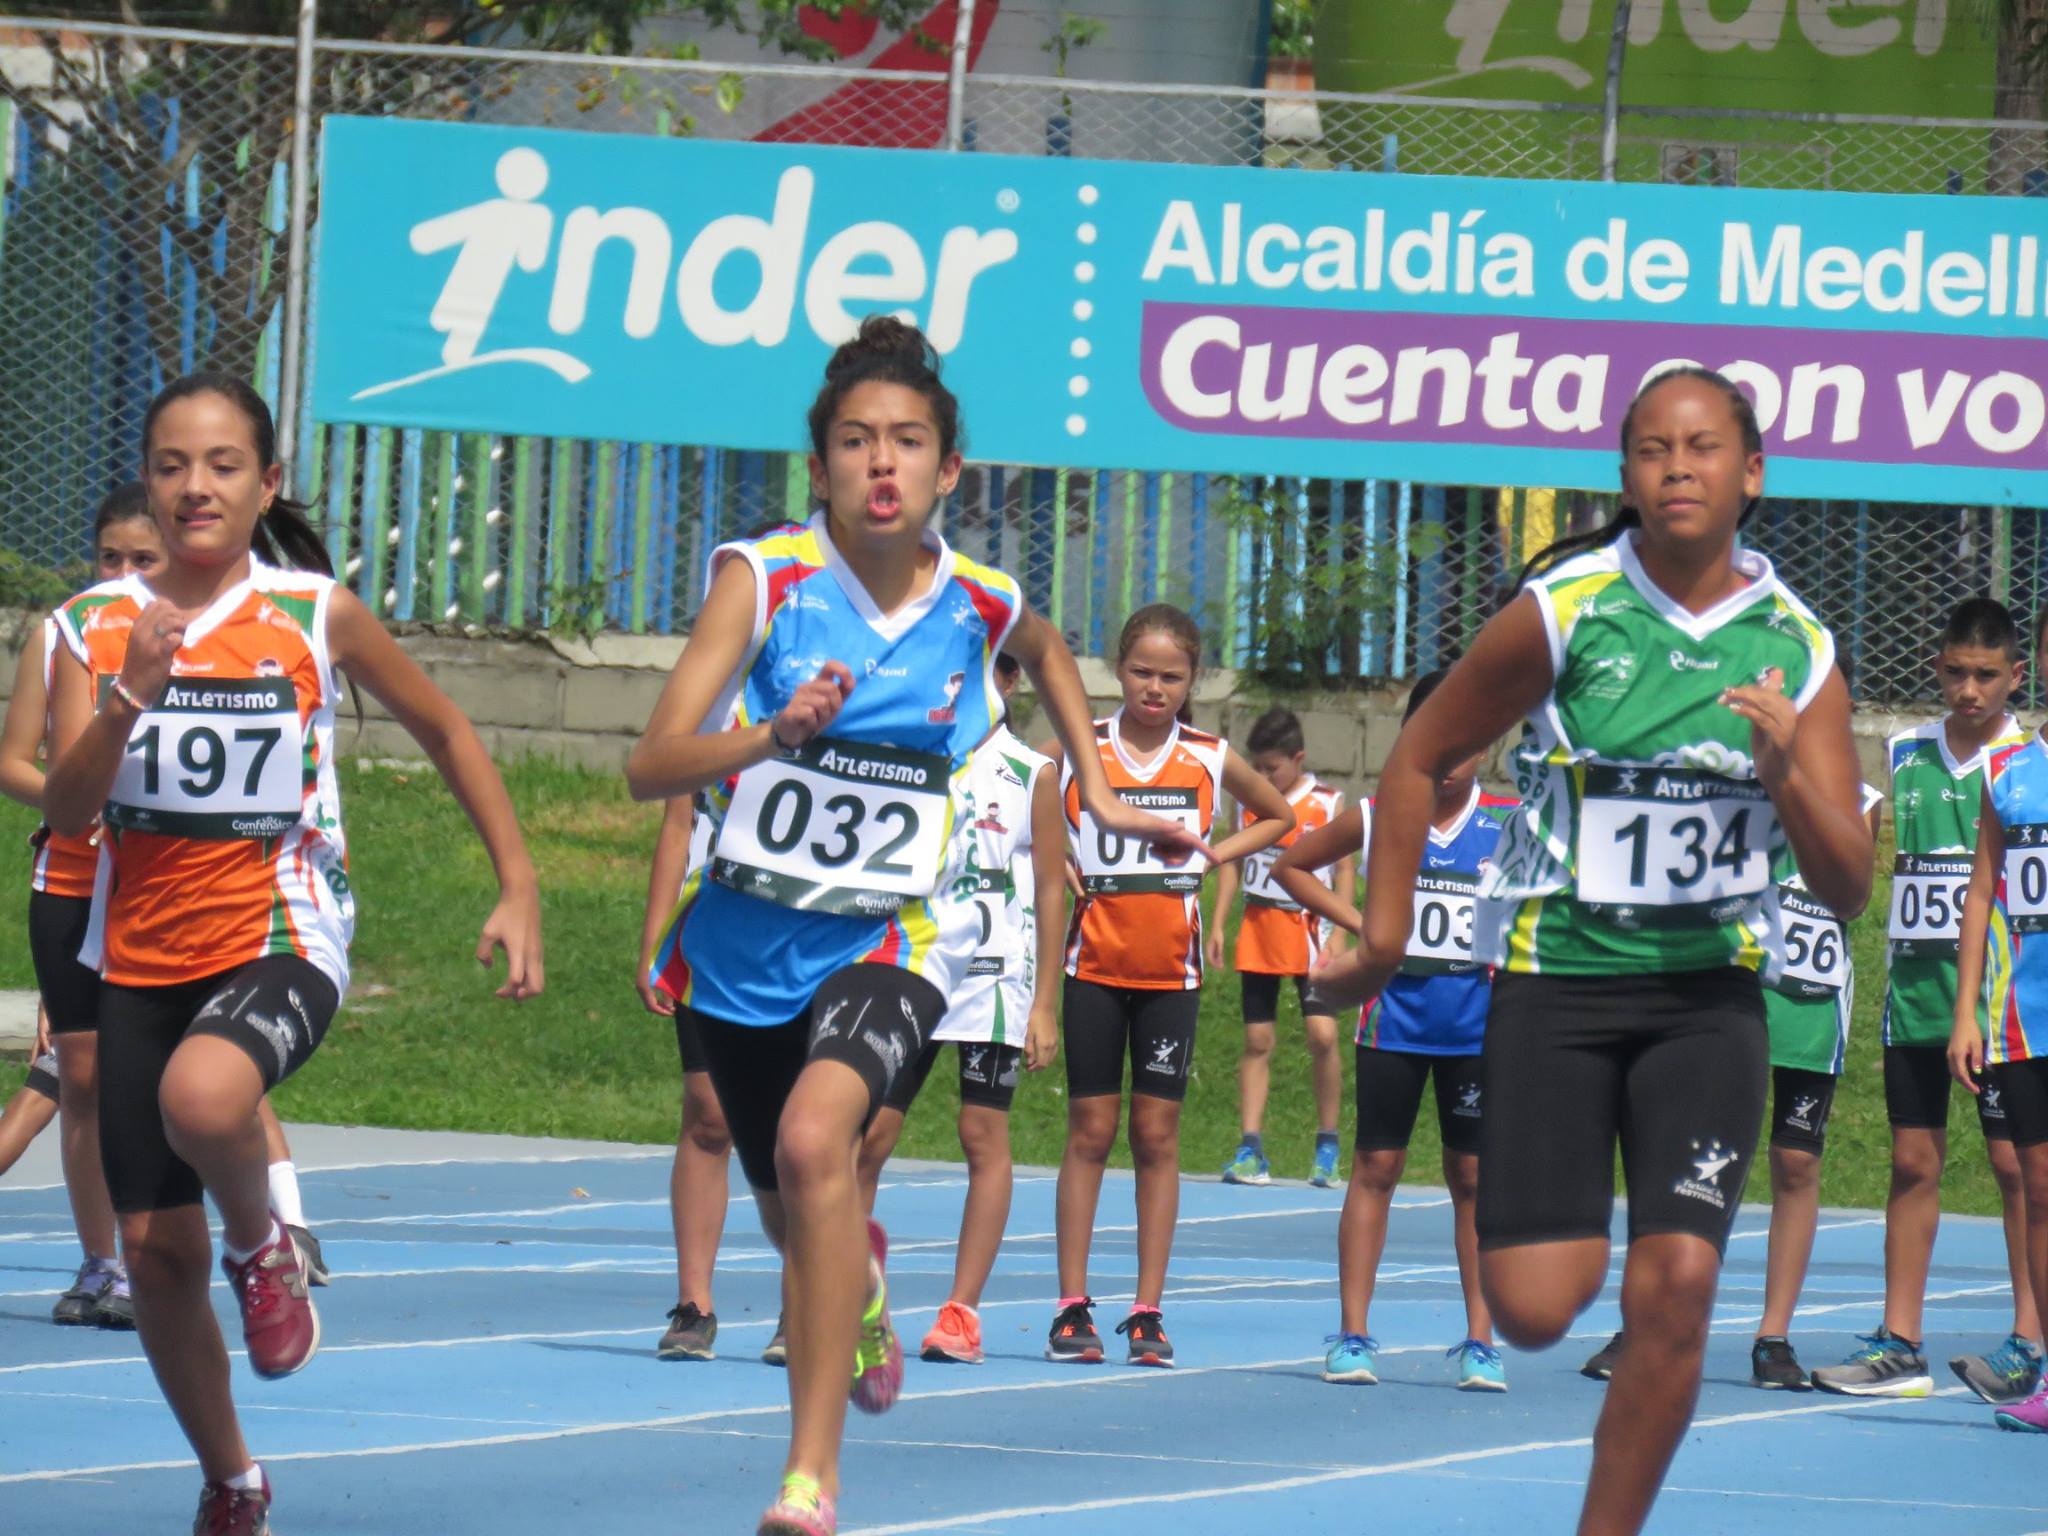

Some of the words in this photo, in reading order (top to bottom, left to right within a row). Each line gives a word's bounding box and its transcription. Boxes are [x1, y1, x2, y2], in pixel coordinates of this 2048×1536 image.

[1141, 200, 1535, 297] Alcaldía
[1565, 218, 1690, 303] de
[1720, 222, 2048, 318] Medell
[1160, 315, 1609, 433] Cuenta
[1637, 358, 1865, 443] on
[1896, 370, 2048, 453] vo
[127, 725, 282, 798] 197
[756, 779, 920, 877] 032
[1614, 808, 1752, 889] 134
